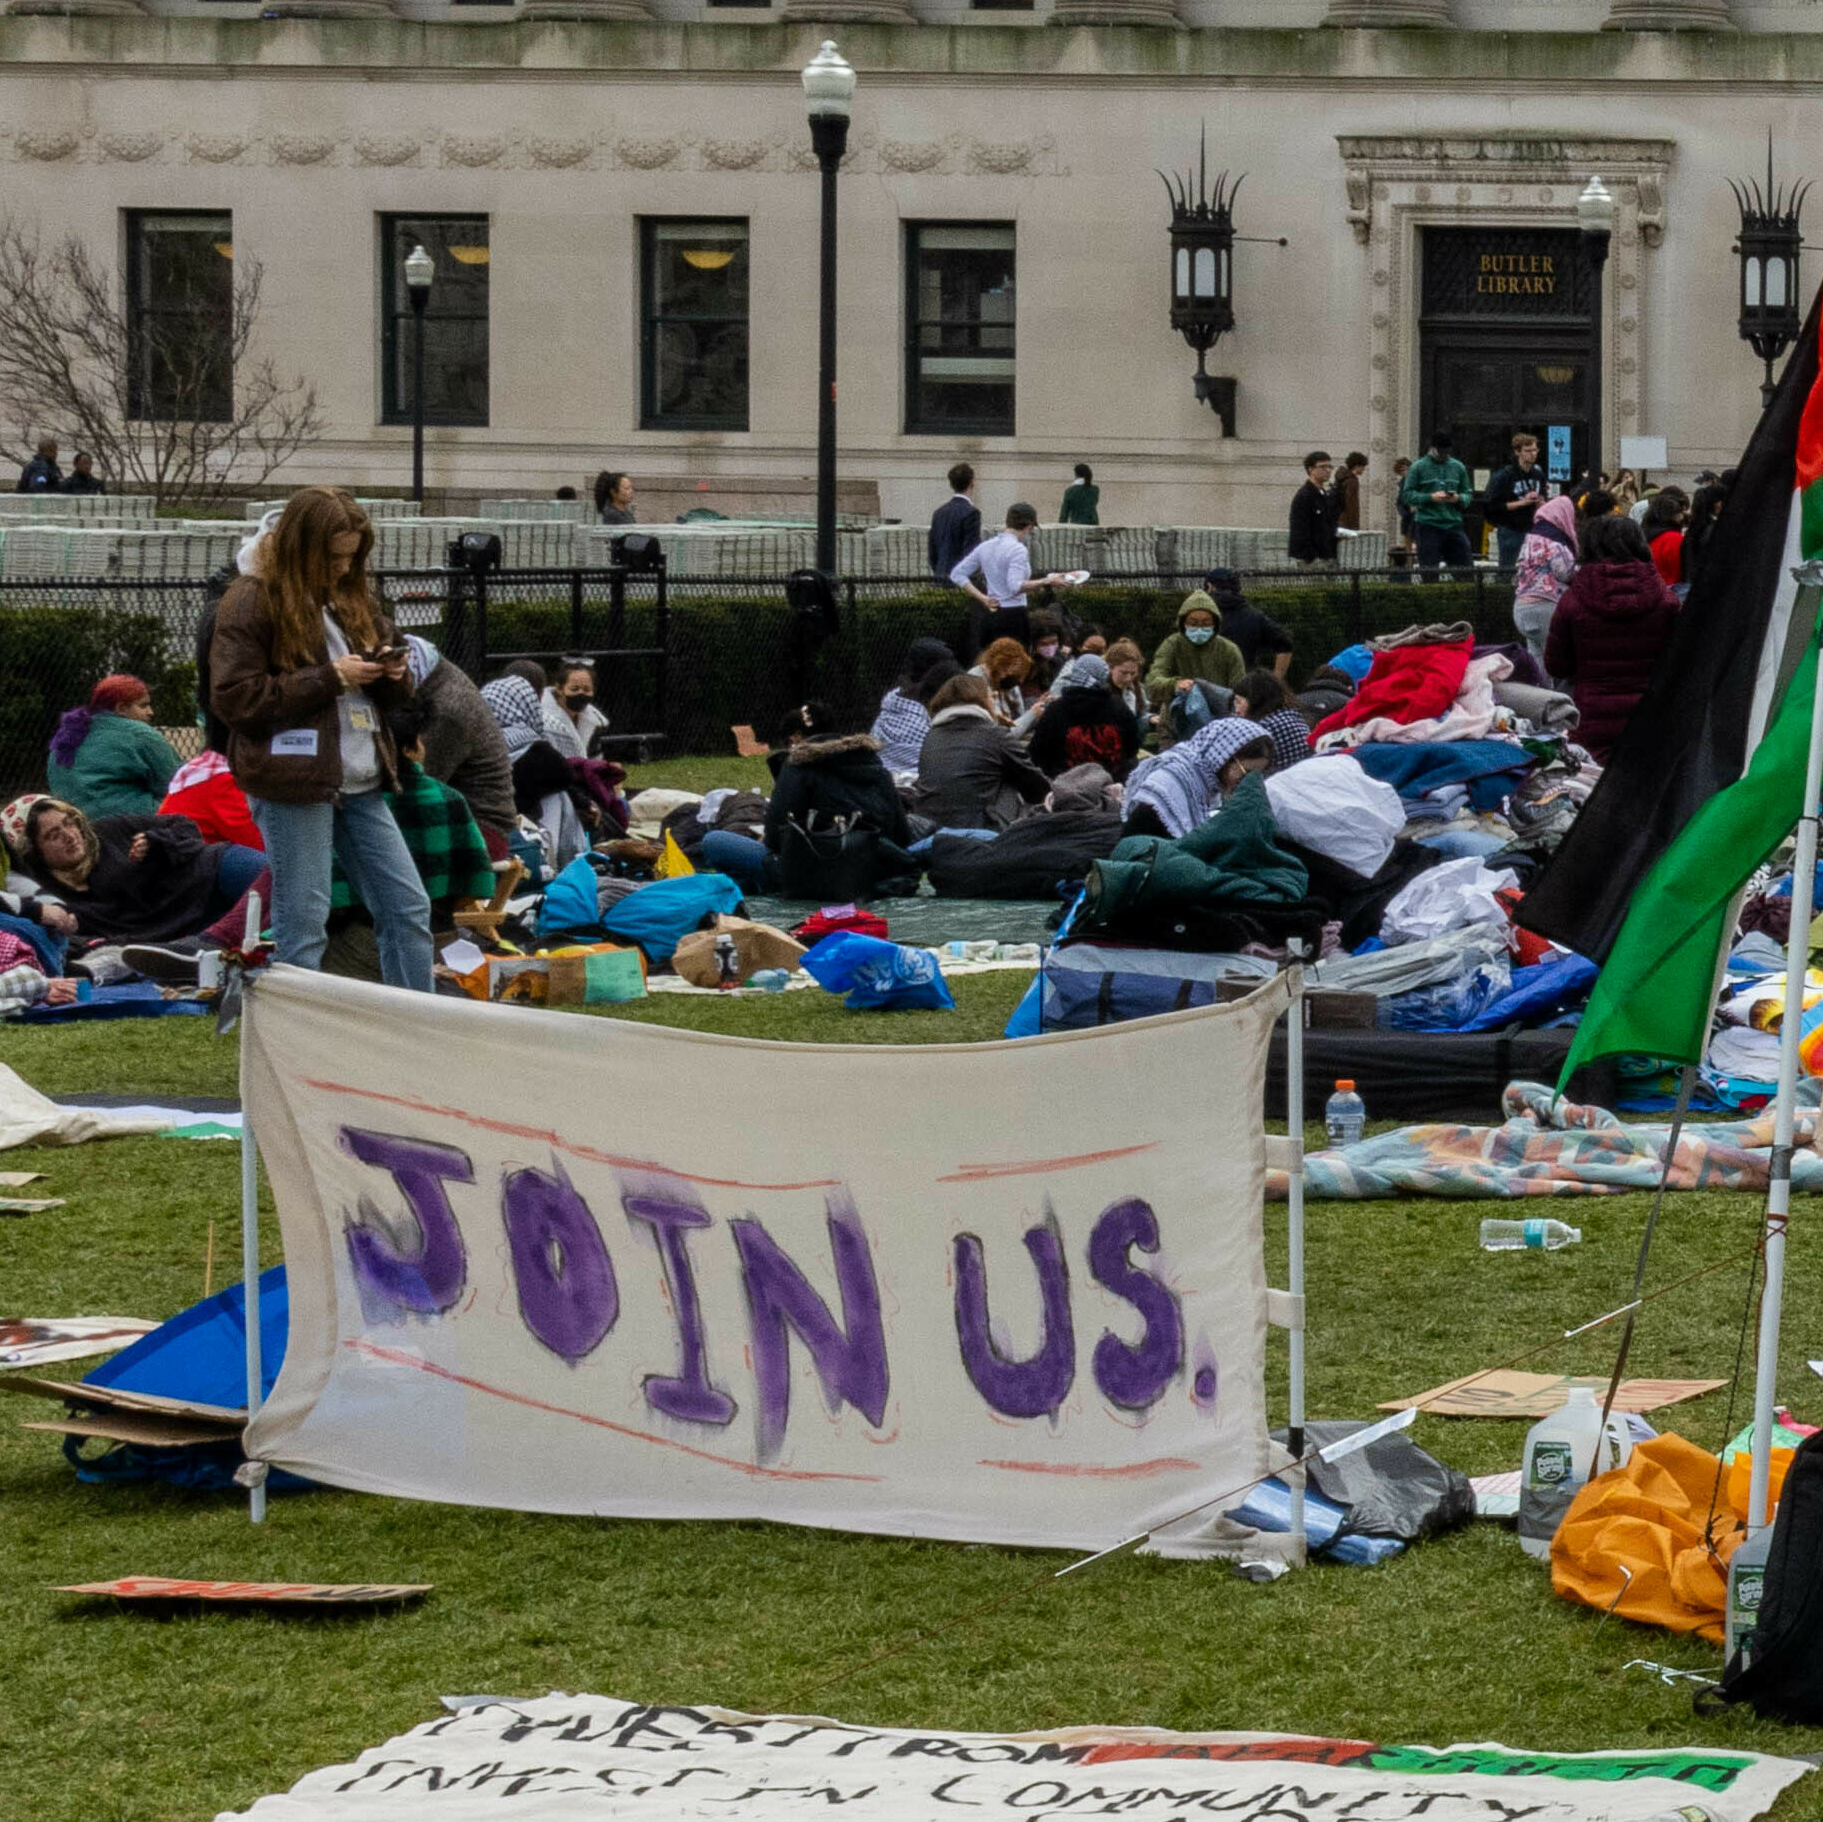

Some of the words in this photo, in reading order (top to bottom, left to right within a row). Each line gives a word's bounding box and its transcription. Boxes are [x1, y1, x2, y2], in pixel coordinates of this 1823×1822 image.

[1480, 254, 1554, 274] BUTLER
[1477, 276, 1556, 295] LIBRARY
[338, 1122, 890, 1463] JOIN
[952, 1193, 1219, 1419] US.
